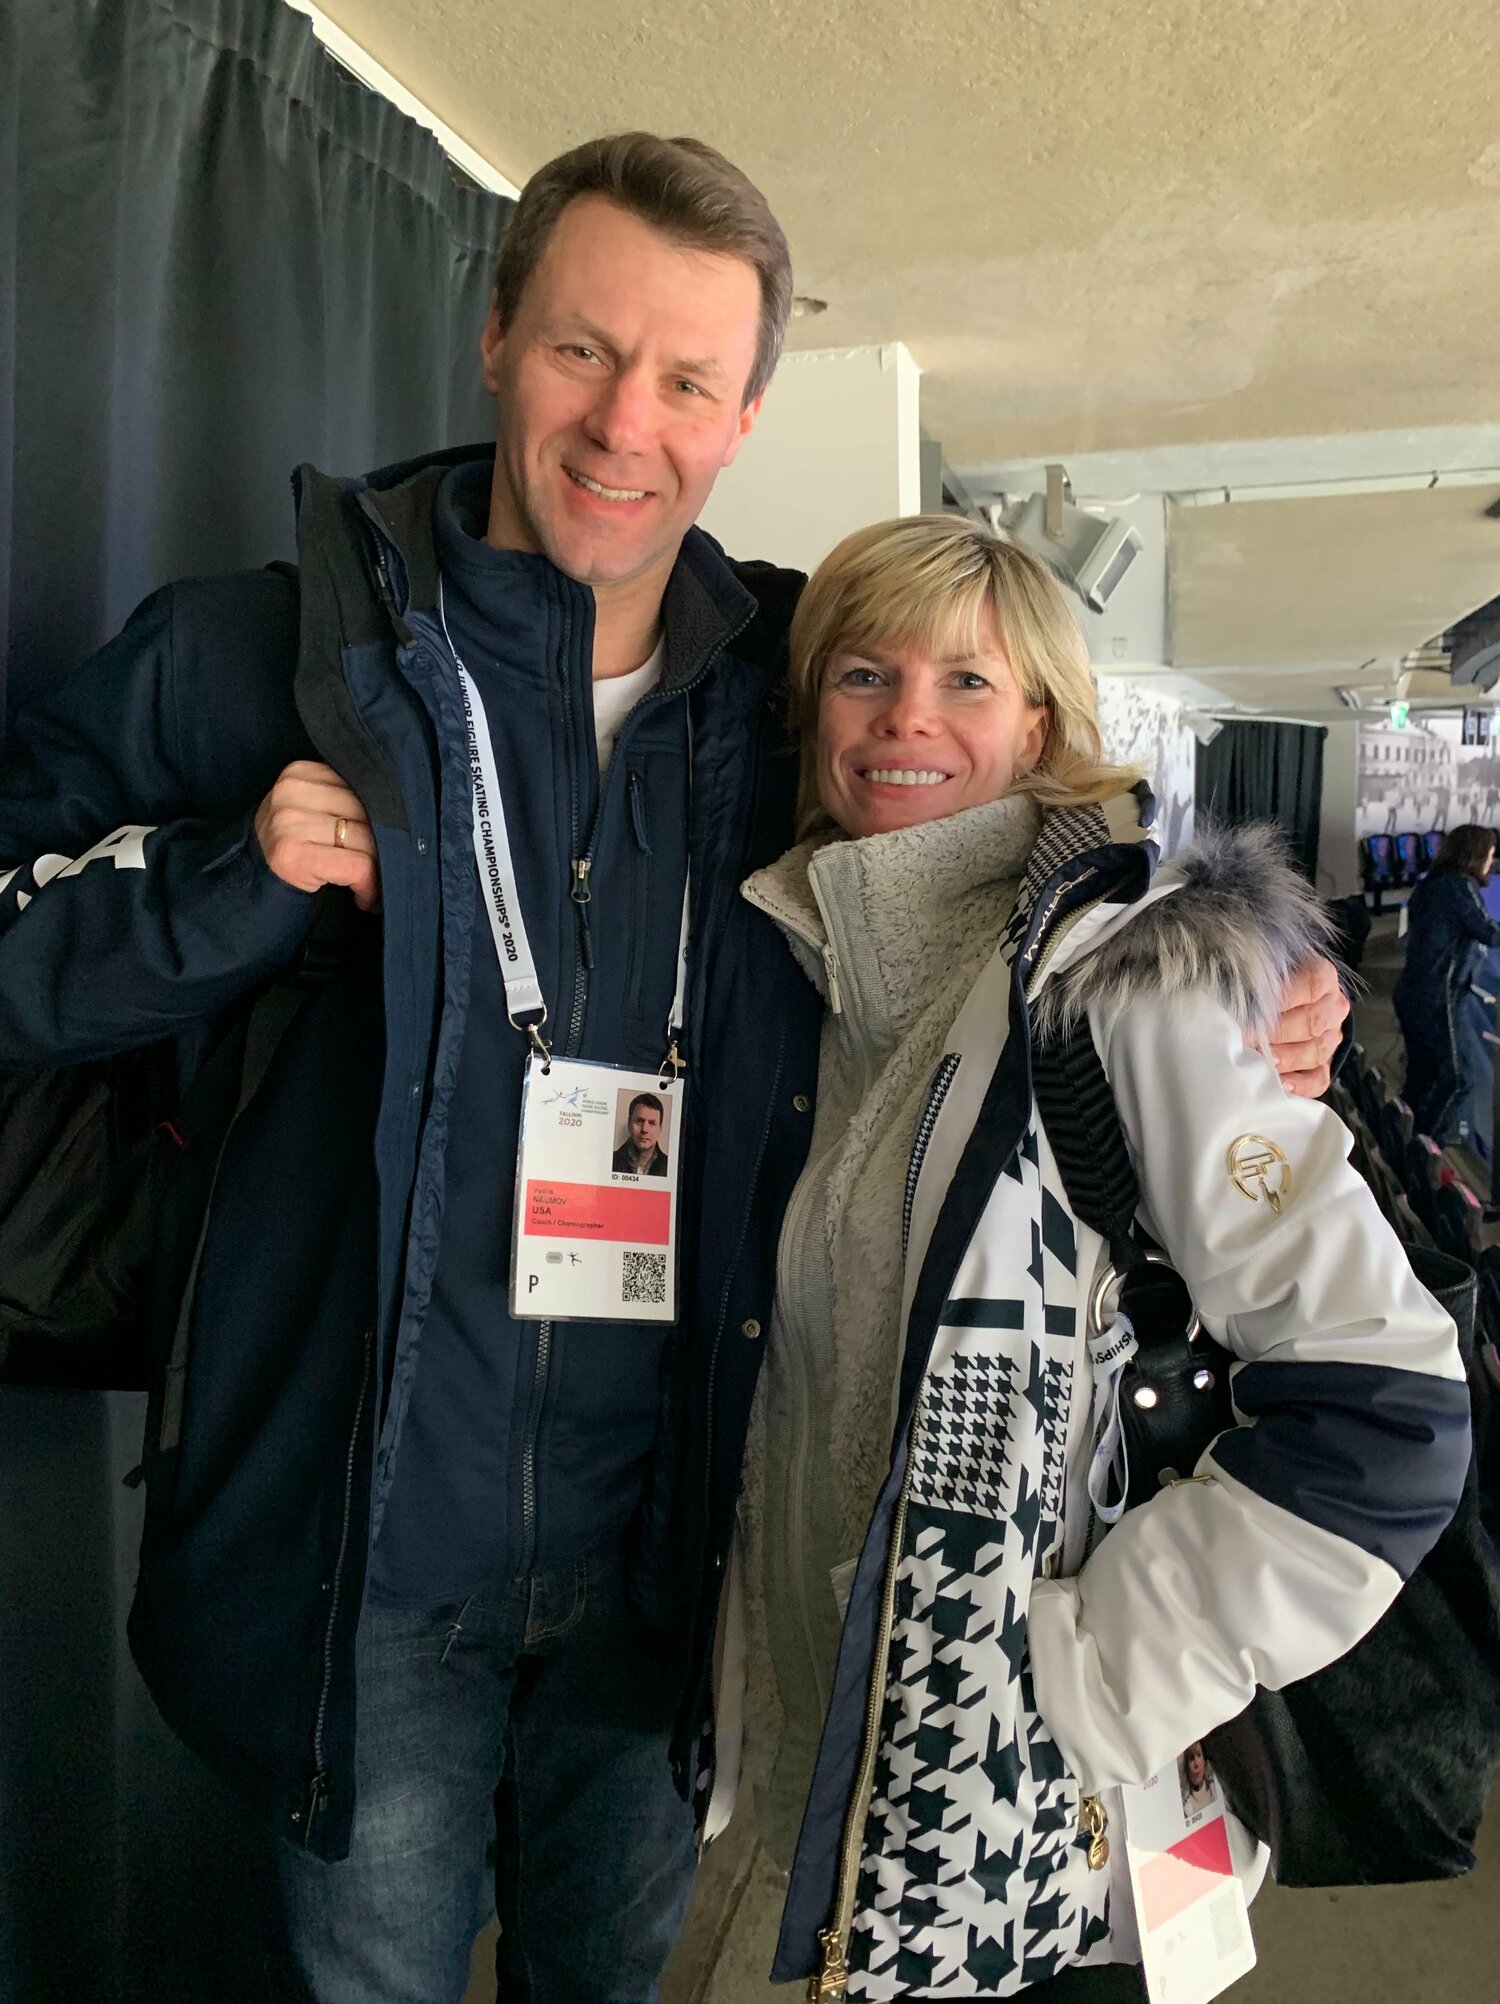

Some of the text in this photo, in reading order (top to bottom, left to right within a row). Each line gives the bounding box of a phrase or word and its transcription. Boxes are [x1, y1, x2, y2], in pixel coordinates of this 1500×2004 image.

[467, 720, 480, 764] FIGURE
[471, 766, 490, 818] SKATING
[502, 932, 518, 962] 2020
[558, 1117, 582, 1127] 2020
[533, 1196, 567, 1205] NAUMOV
[532, 1206, 552, 1216] USA
[528, 1274, 539, 1293] P
